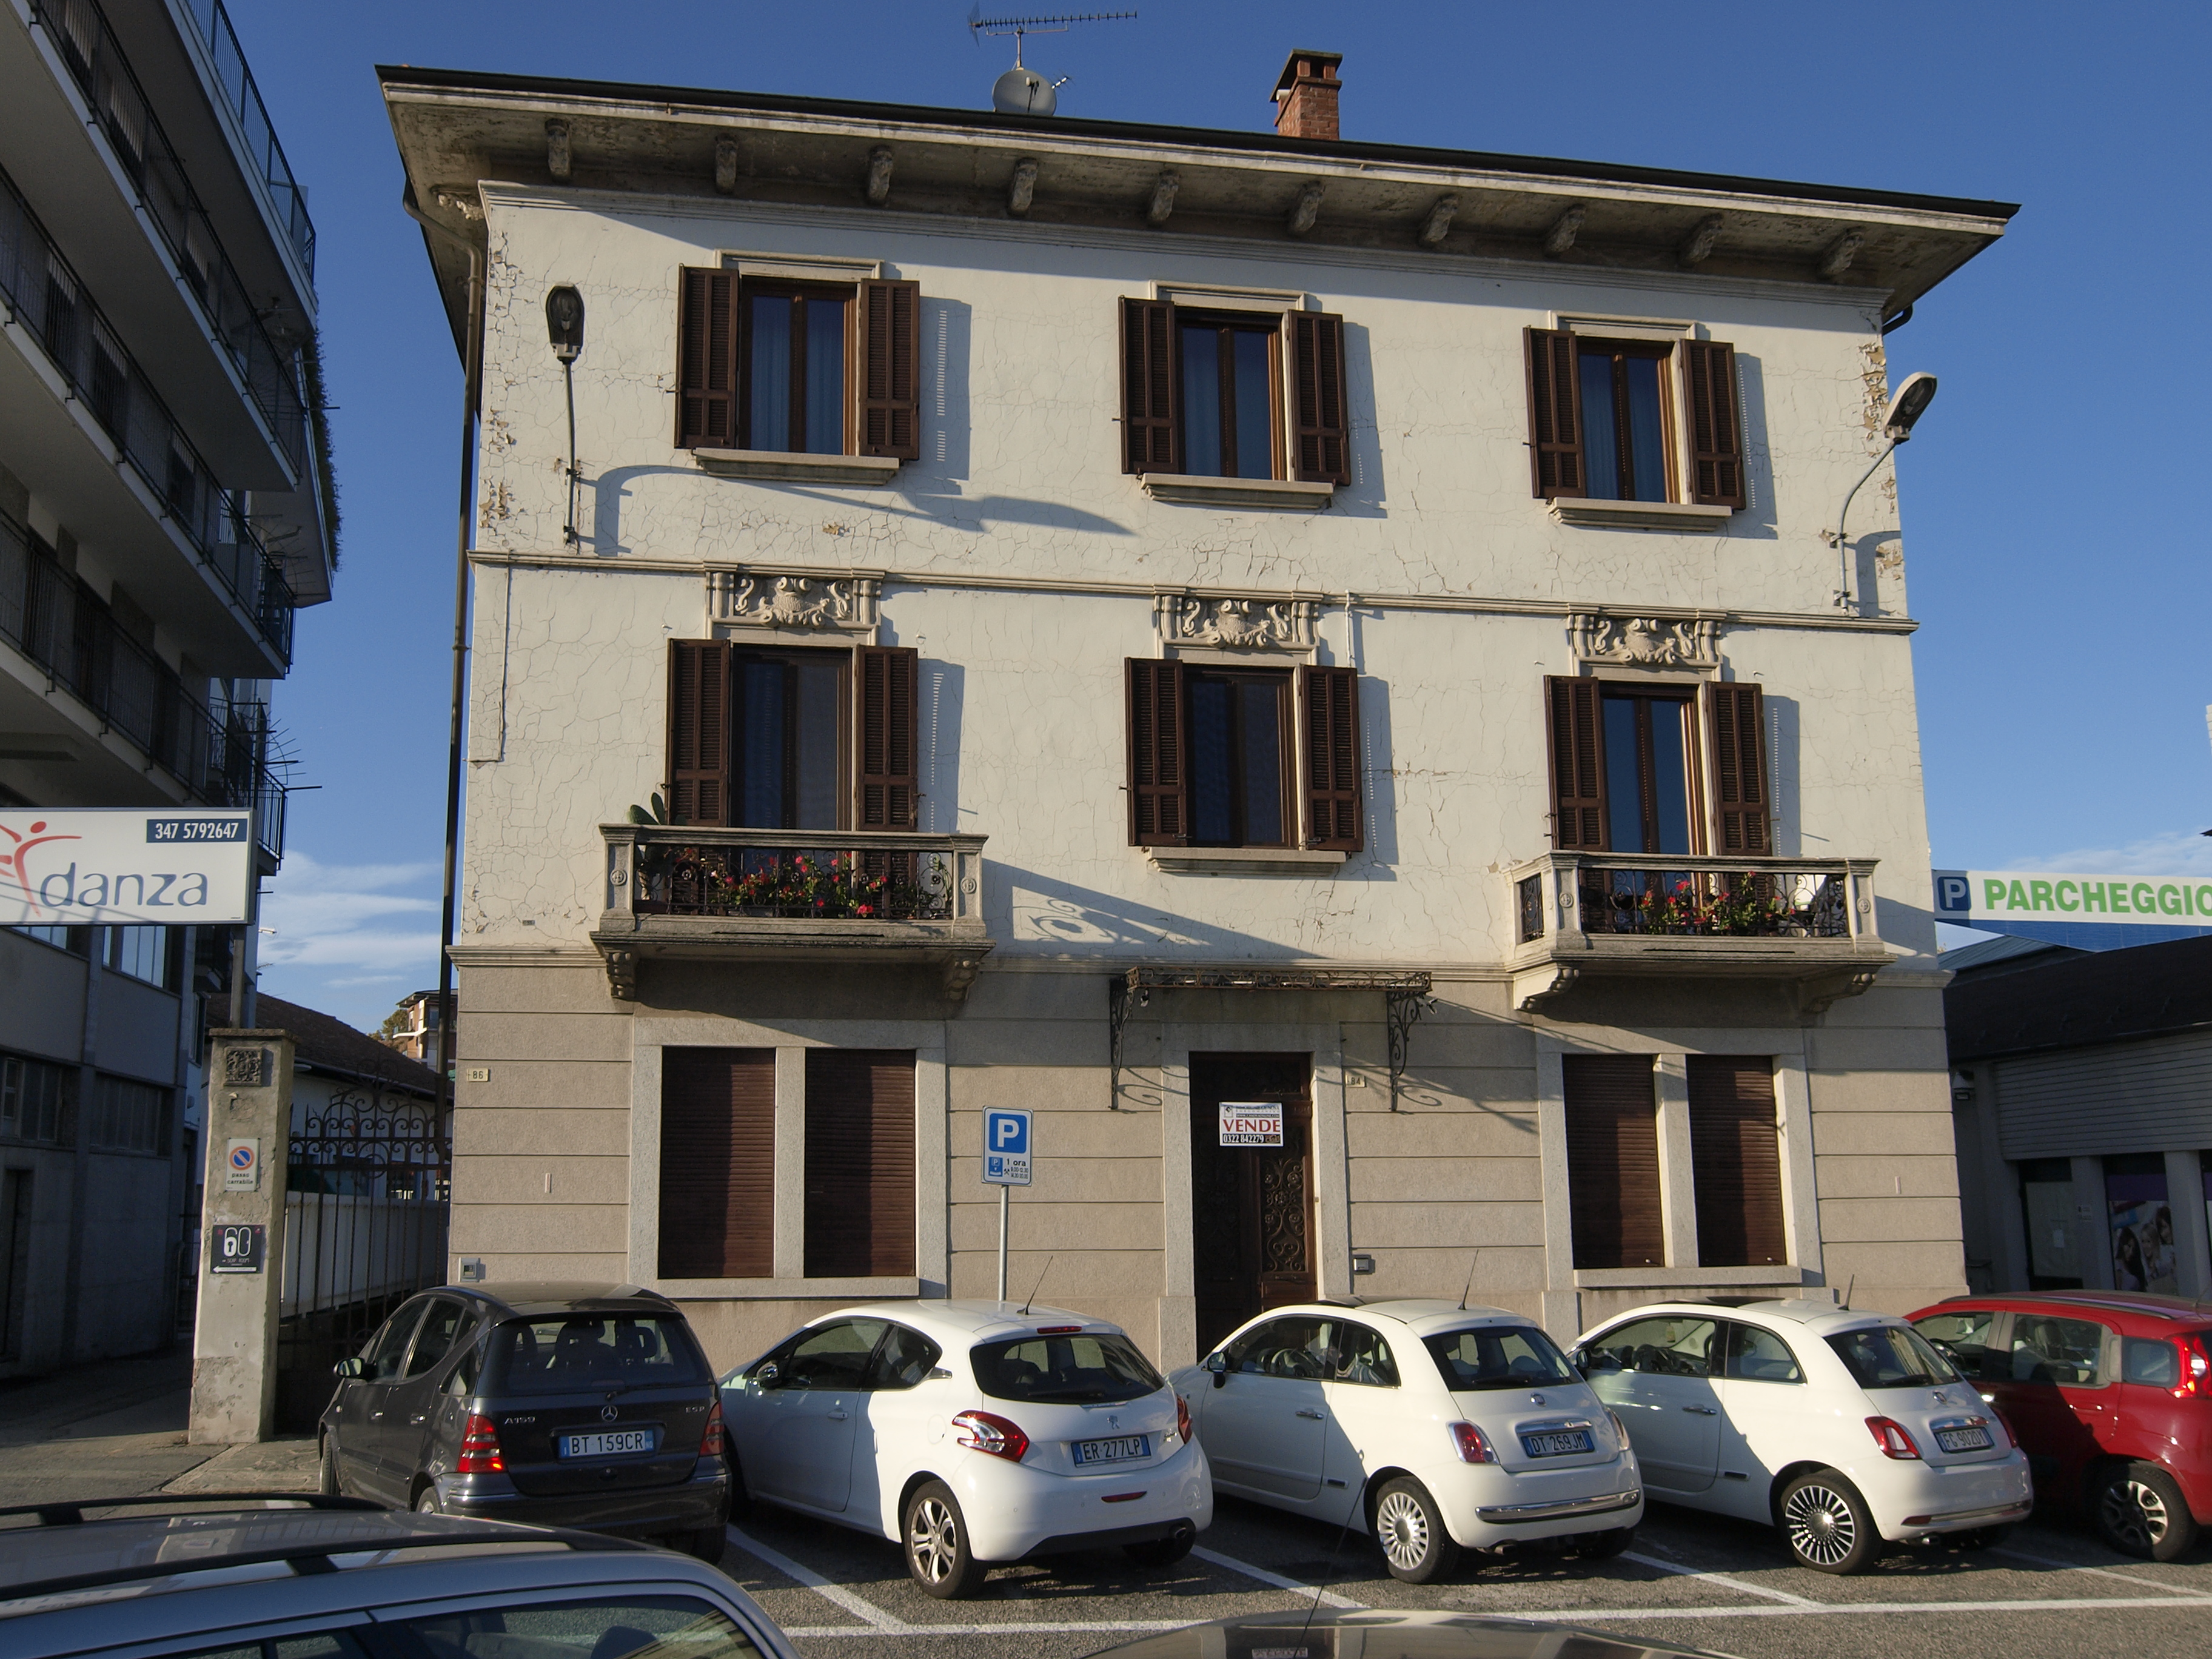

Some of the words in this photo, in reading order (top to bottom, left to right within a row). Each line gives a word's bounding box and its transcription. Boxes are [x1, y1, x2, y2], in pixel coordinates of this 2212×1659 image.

[155, 822, 178, 839] 347
[183, 822, 239, 839] 5792647
[40, 862, 208, 907] danza
[1943, 879, 1966, 908] P
[1983, 879, 2212, 917] PARCHEGGIO
[473, 1070, 483, 1079] 86
[997, 1119, 1019, 1148] P
[1222, 1119, 1281, 1133] VENDE
[223, 1227, 252, 1257] 60
[572, 1436, 589, 1454] BT
[597, 1433, 643, 1452] 159CR
[1083, 1443, 1100, 1460] ER
[1103, 1438, 1140, 1458] 277LP
[1530, 1436, 1547, 1452] DT
[1549, 1433, 1586, 1450] 269JM
